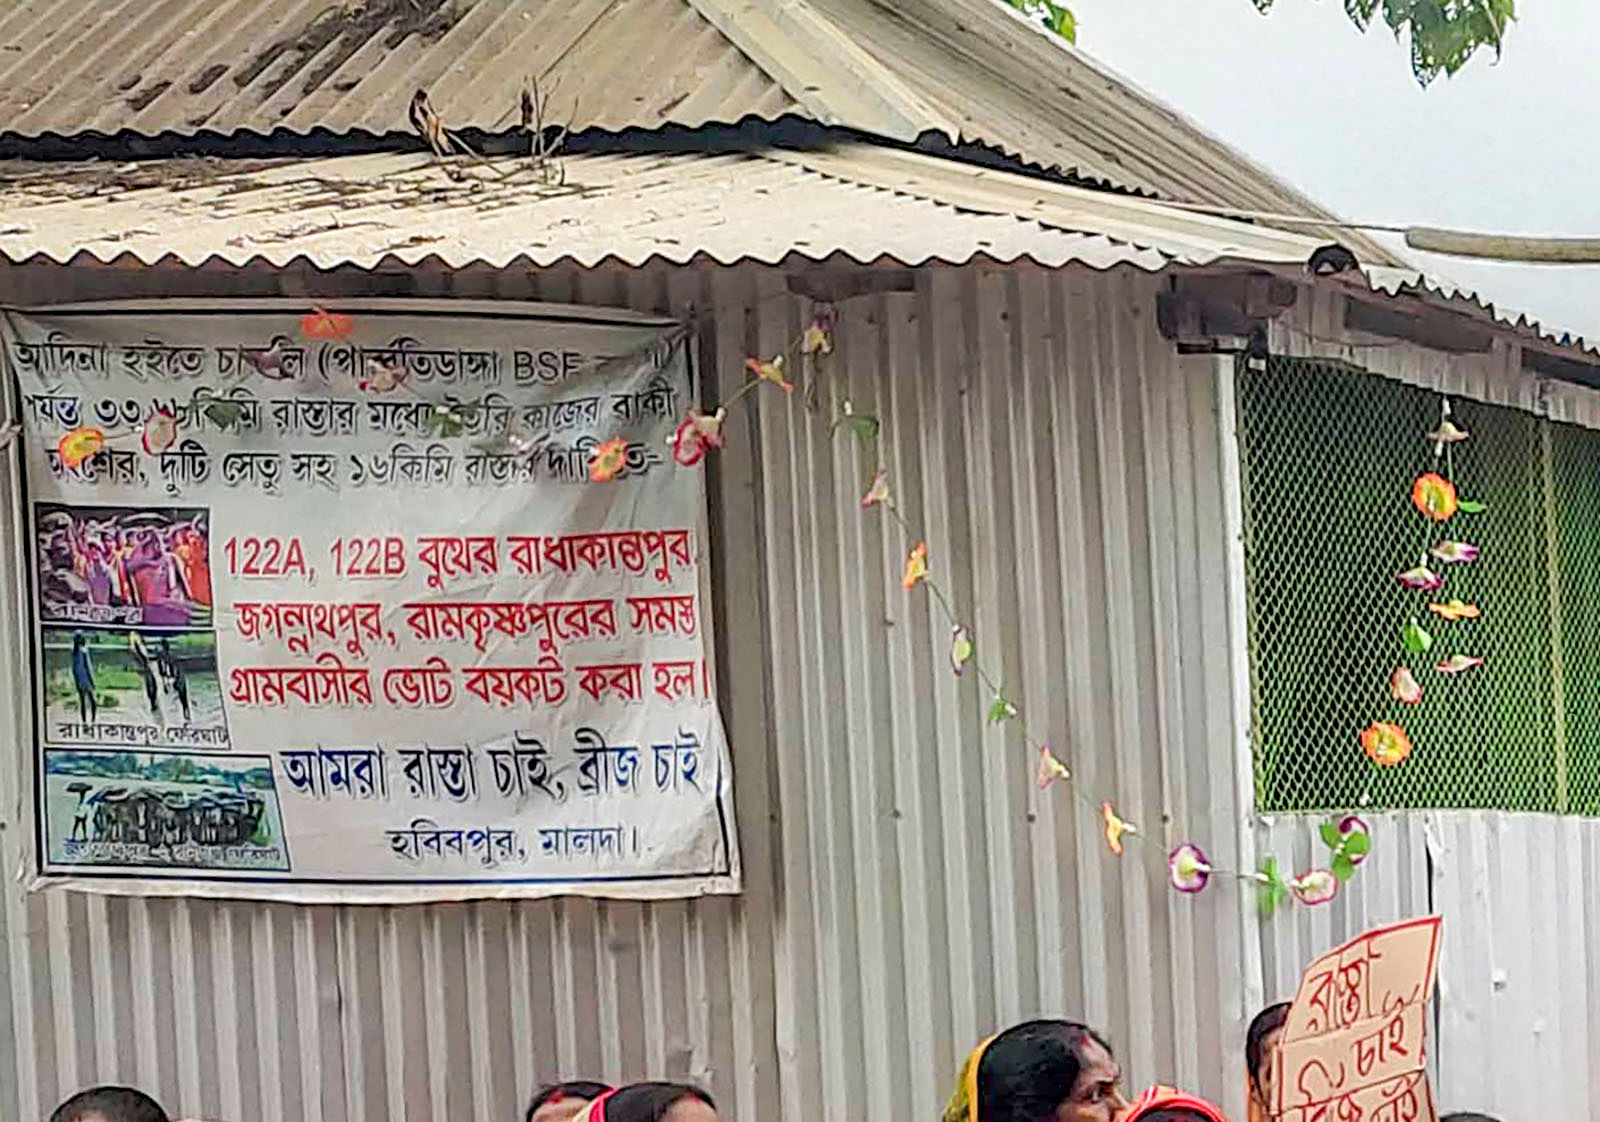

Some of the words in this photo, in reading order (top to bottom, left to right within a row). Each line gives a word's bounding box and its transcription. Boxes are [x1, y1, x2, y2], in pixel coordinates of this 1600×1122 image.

[13, 332, 108, 382] আদিনা
[122, 340, 206, 382] হইতে
[513, 349, 581, 384] BSF
[272, 396, 354, 433] রাস্তার
[612, 377, 675, 419] বাকী
[160, 440, 208, 492] দুটি
[222, 452, 281, 492] সেতু
[289, 452, 333, 486] সহ
[224, 536, 316, 582] 122A,
[330, 536, 406, 576] 122B
[416, 537, 498, 591] বুথের
[233, 601, 397, 658] জগন্নাথপুর,
[402, 598, 616, 656] রামকৃষ্ণপুরের
[229, 652, 373, 705] গ্রামবাসীর
[382, 656, 453, 705] ভোট
[461, 655, 565, 707] বয়কট
[575, 663, 644, 700] করা
[278, 744, 387, 798] আমরা
[398, 747, 478, 799] রাস্তা
[487, 729, 565, 799] চাই,
[572, 726, 639, 796] ব্রীজ
[650, 725, 704, 796] চাই
[1350, 983, 1421, 1077] চাই
